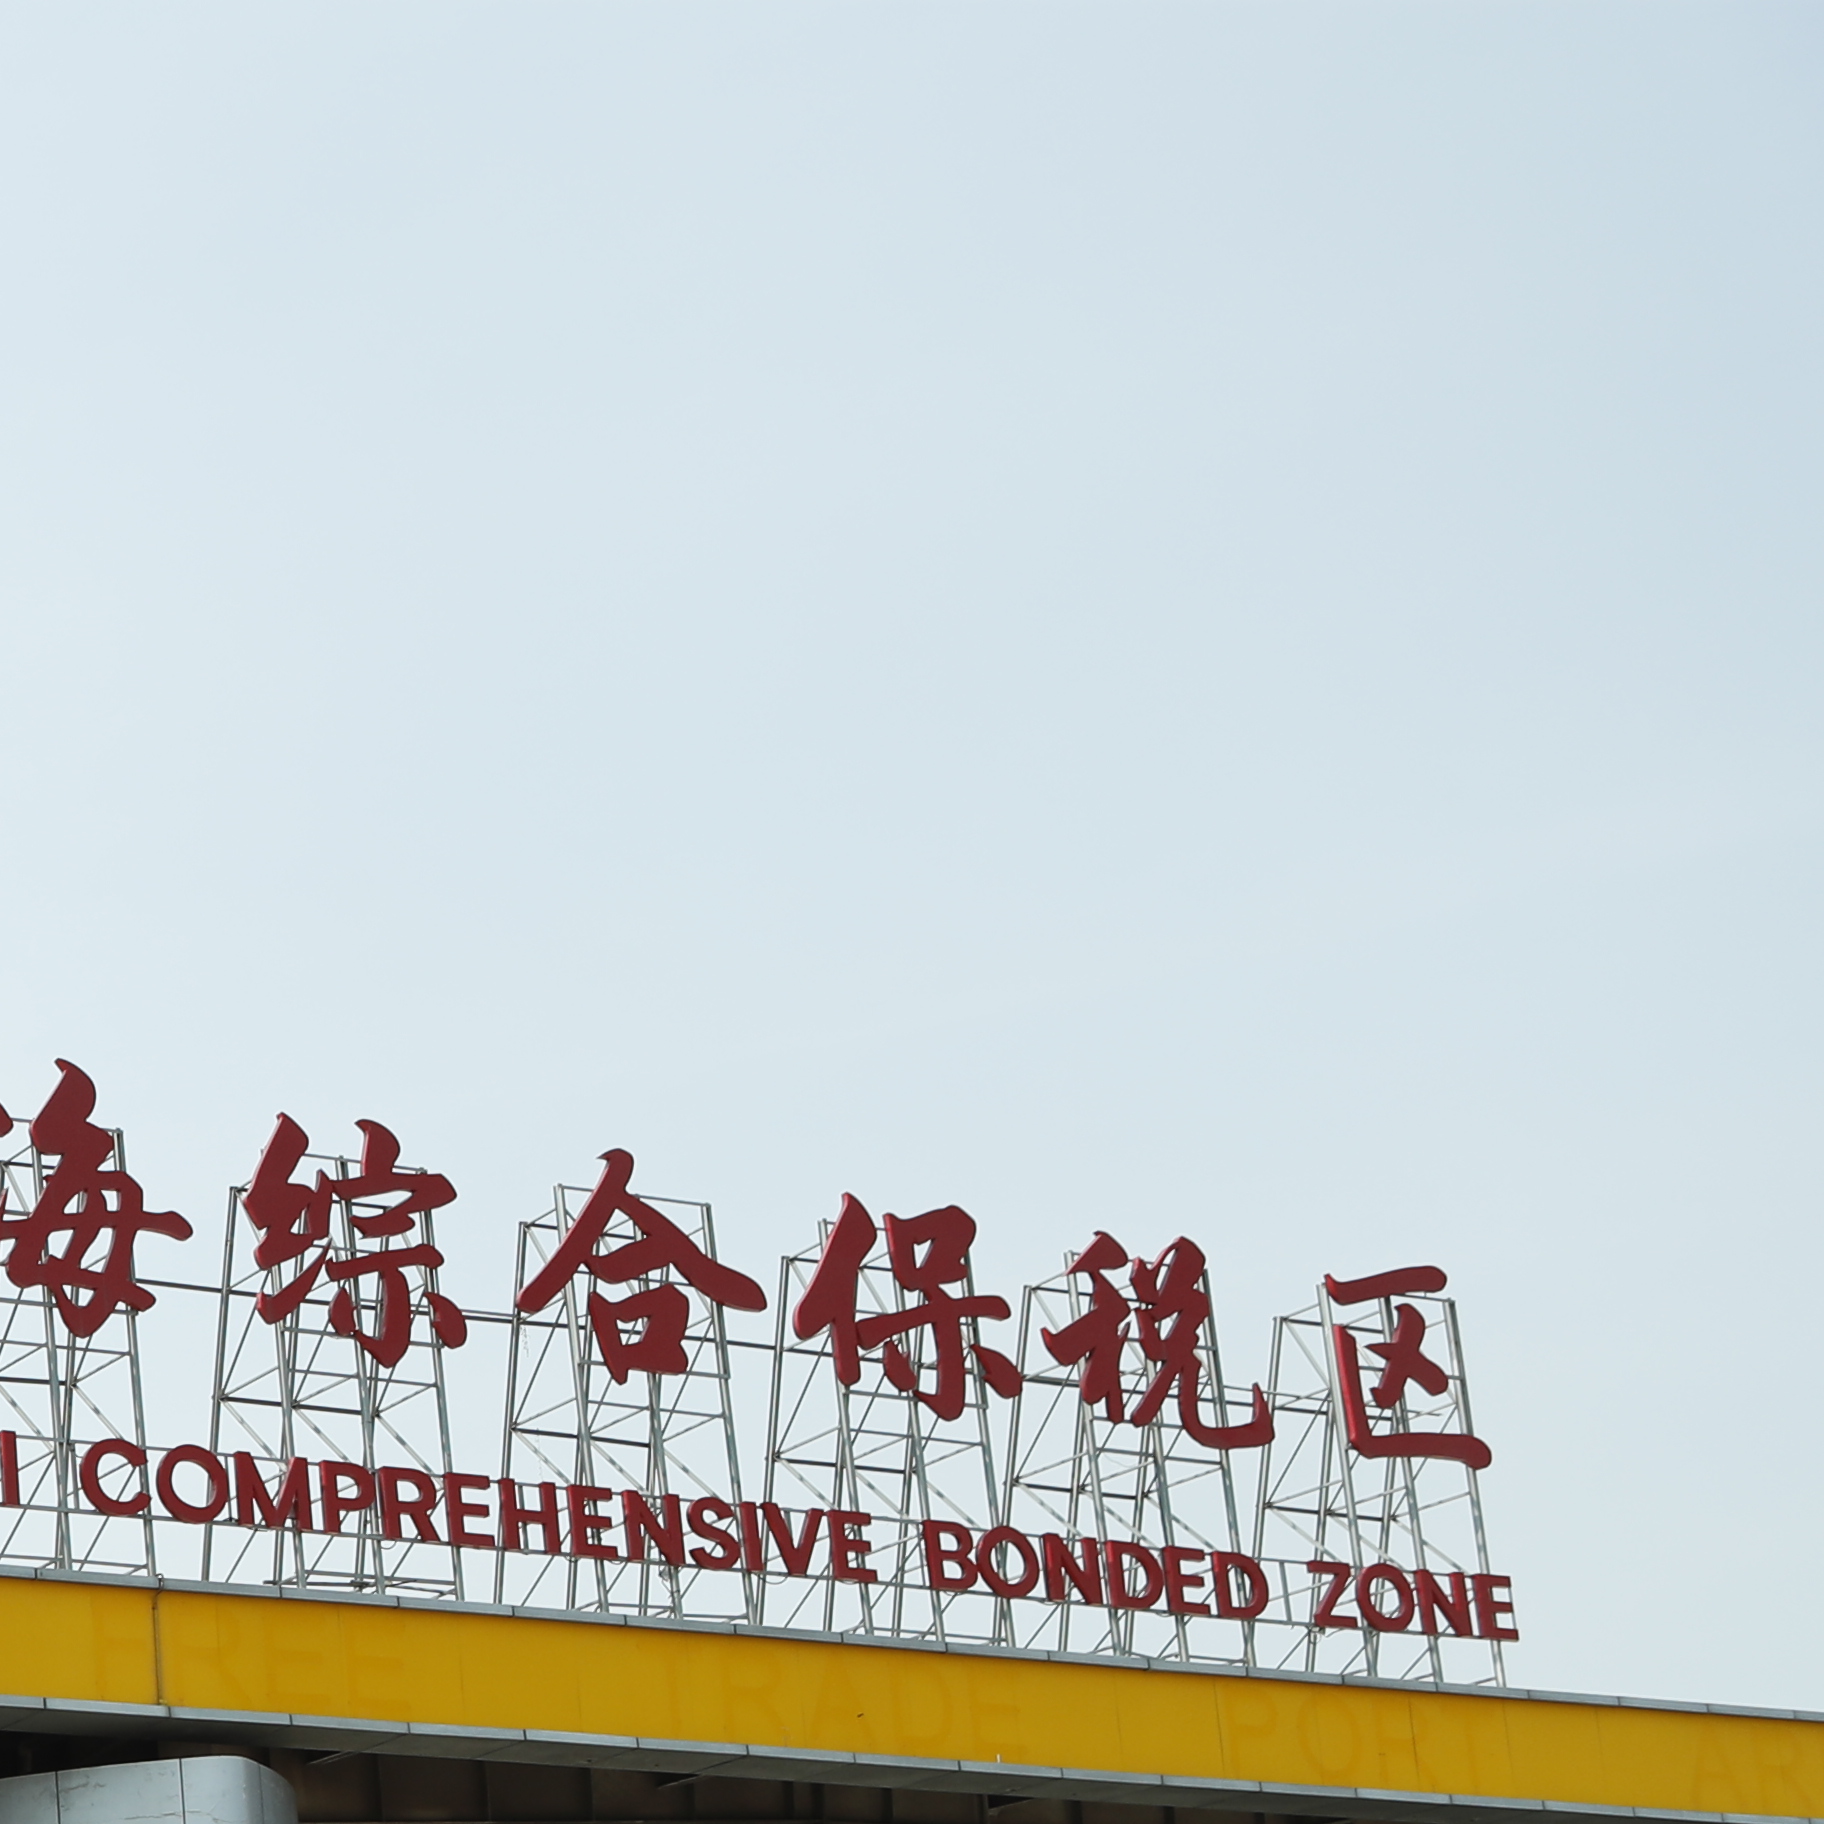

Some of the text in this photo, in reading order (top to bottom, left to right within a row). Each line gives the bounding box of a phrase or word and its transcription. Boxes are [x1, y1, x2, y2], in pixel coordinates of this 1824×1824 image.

[80, 1437, 878, 1583] COMPREHENSIVE
[921, 1519, 1269, 1620] BONDED
[1306, 1560, 1520, 1643] ZONE
